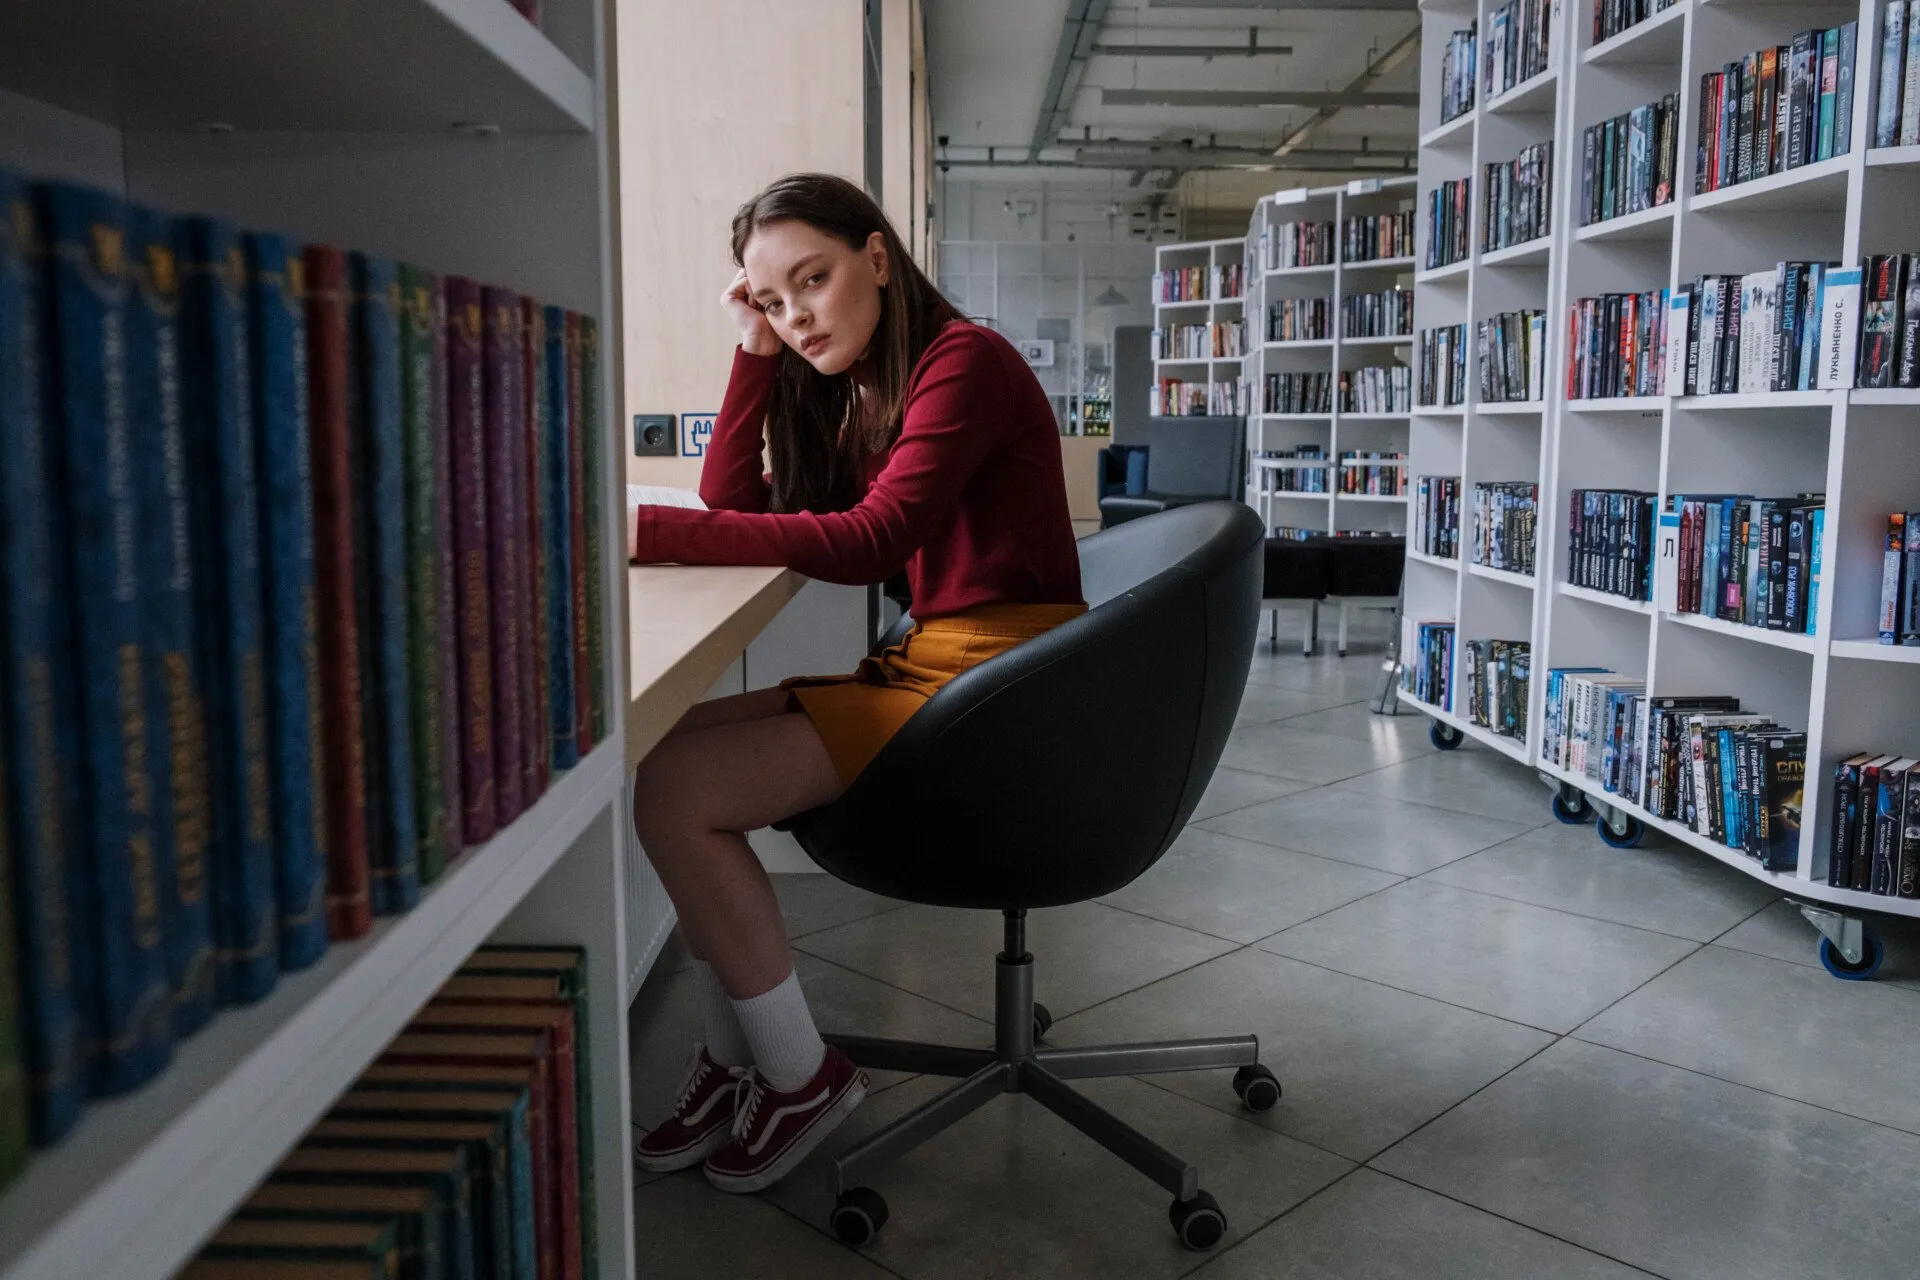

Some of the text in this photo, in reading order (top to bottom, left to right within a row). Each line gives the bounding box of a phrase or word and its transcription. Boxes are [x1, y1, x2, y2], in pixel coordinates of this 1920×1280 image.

[1760, 128, 1768, 172] КРОНИН
[1790, 105, 1802, 165] ЦЕРБЕР
[1716, 282, 1727, 312] КУНЦ
[1731, 280, 1741, 309] КУНЦ
[1785, 270, 1798, 301] КУНЦ
[1714, 314, 1725, 338] ДИН
[1729, 312, 1740, 336] ДИН
[1783, 304, 1794, 331] ДИН
[1687, 302, 1700, 385] ДИН КУНЦ ГОРОД
[1771, 333, 1781, 359] КУНЦ
[1829, 298, 1843, 381] ЛУКЬЯНЕНКО С.
[1770, 362, 1779, 381] ДИН
[1663, 538, 1674, 558] Л
[1785, 566, 1797, 617] ЛЮБОВНИК РОЗ
[1589, 687, 1600, 747] КОРЧЕВСКИЙ
[1836, 793, 1848, 853] СТЕКЛЯННЫЙ ТРОН
